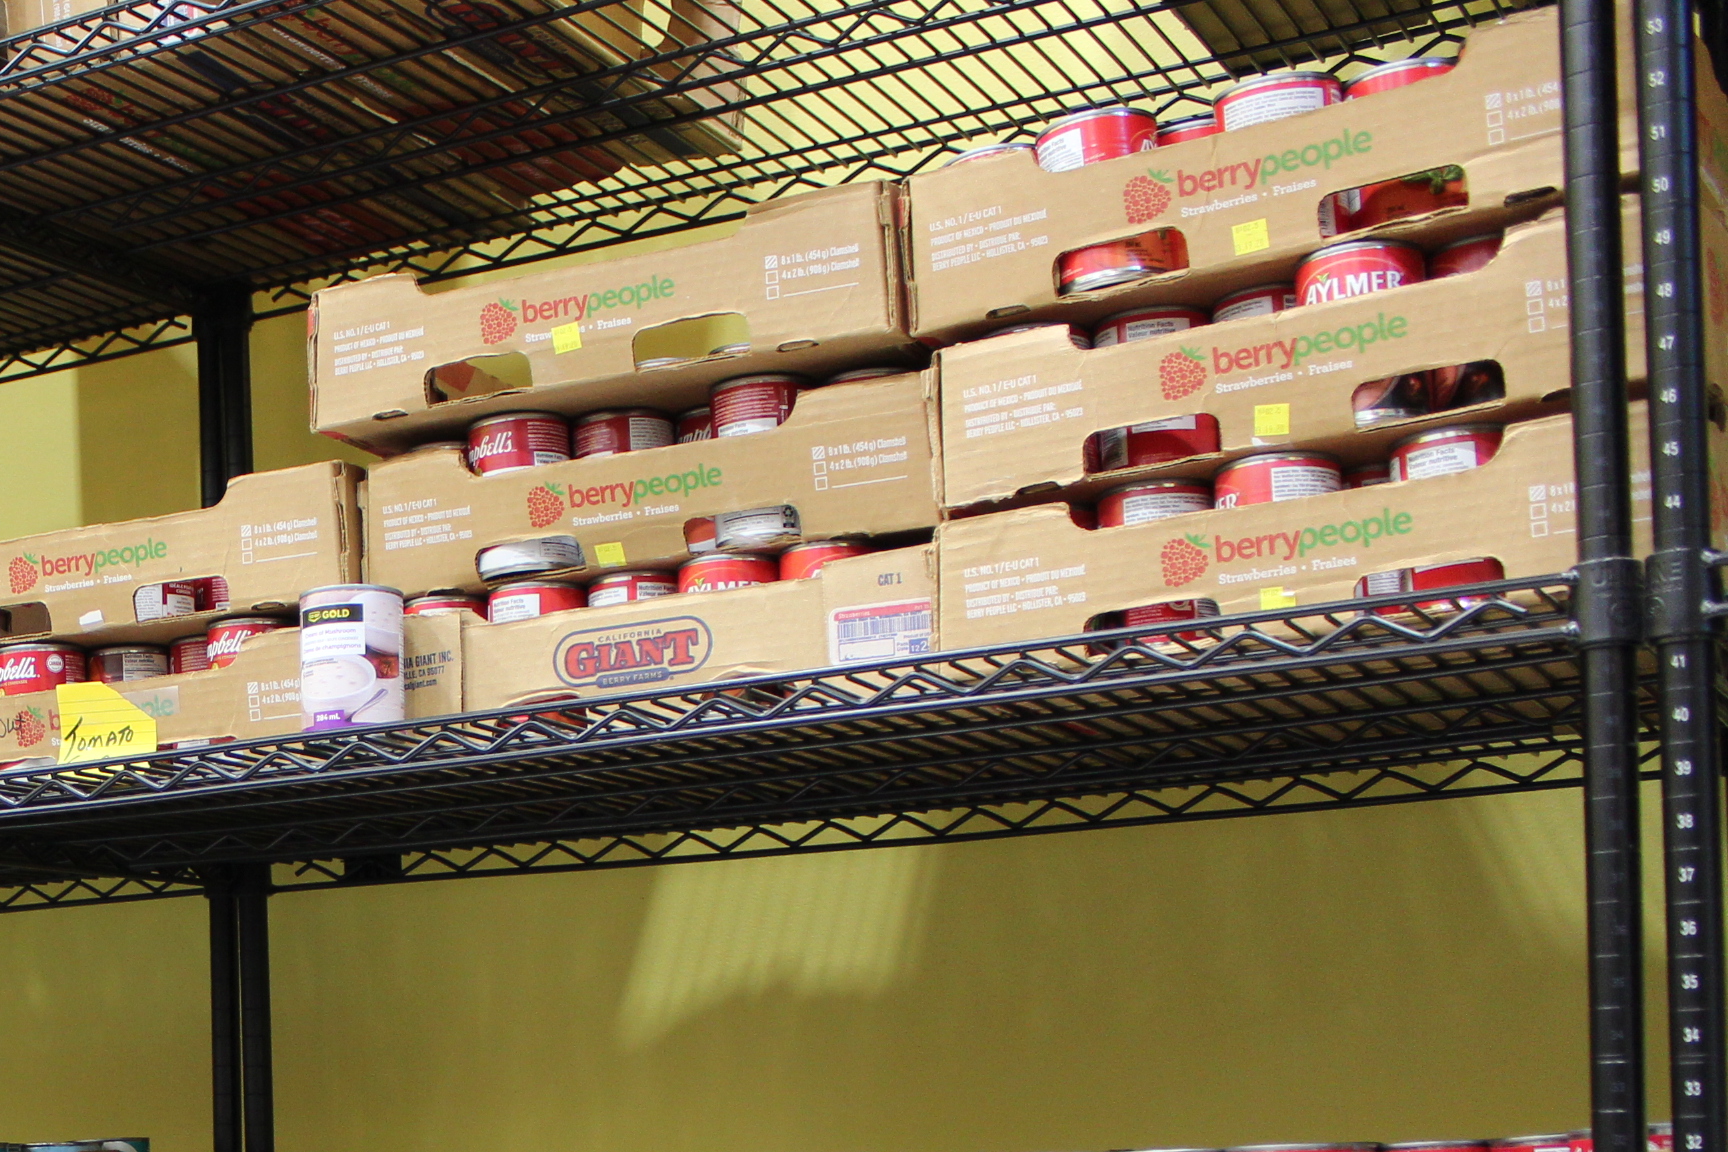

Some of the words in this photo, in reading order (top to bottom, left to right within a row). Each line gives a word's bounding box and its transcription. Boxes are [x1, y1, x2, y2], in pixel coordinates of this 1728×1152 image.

[1647, 19, 1662, 33] 53
[1650, 72, 1664, 86] 52
[1651, 125, 1665, 139] 51
[1177, 127, 1373, 198] berrypeople
[1652, 178, 1669, 192] 50
[1181, 193, 1257, 218] Strawberries
[1273, 178, 1317, 197] Fraises
[1655, 230, 1671, 245] 49
[1305, 270, 1403, 306] AYLMER
[1657, 283, 1672, 298] 48
[522, 272, 676, 323] berrypeople
[1213, 311, 1408, 376] berrypeople
[1658, 336, 1674, 350] 47
[1216, 371, 1293, 394] Strawberries
[1308, 358, 1353, 376] Fraises
[1660, 389, 1676, 403] 46
[1663, 442, 1679, 456] 45
[568, 463, 723, 509] berrypeople
[1664, 494, 1681, 509] 44
[572, 510, 634, 528] Strawberries
[644, 502, 680, 518] Fraises
[1215, 508, 1413, 562] berrypeople
[41, 537, 167, 578] berrypeople
[1219, 567, 1297, 585] Strawberries
[1312, 556, 1358, 572] Fraises
[878, 573, 896, 587] CAT
[322, 607, 350, 620] GOLD
[439, 651, 455, 663] INC.
[565, 627, 700, 679] GIANT
[1672, 654, 1686, 669] 41
[1673, 707, 1689, 722] 40
[1675, 760, 1692, 776] 39
[1676, 814, 1694, 829] 38
[1678, 867, 1695, 882] 37
[1680, 920, 1697, 936] 36
[1682, 975, 1698, 990] 35
[1683, 1028, 1700, 1043] 34
[1684, 1081, 1701, 1096] 33
[1685, 1134, 1702, 1149] 32
